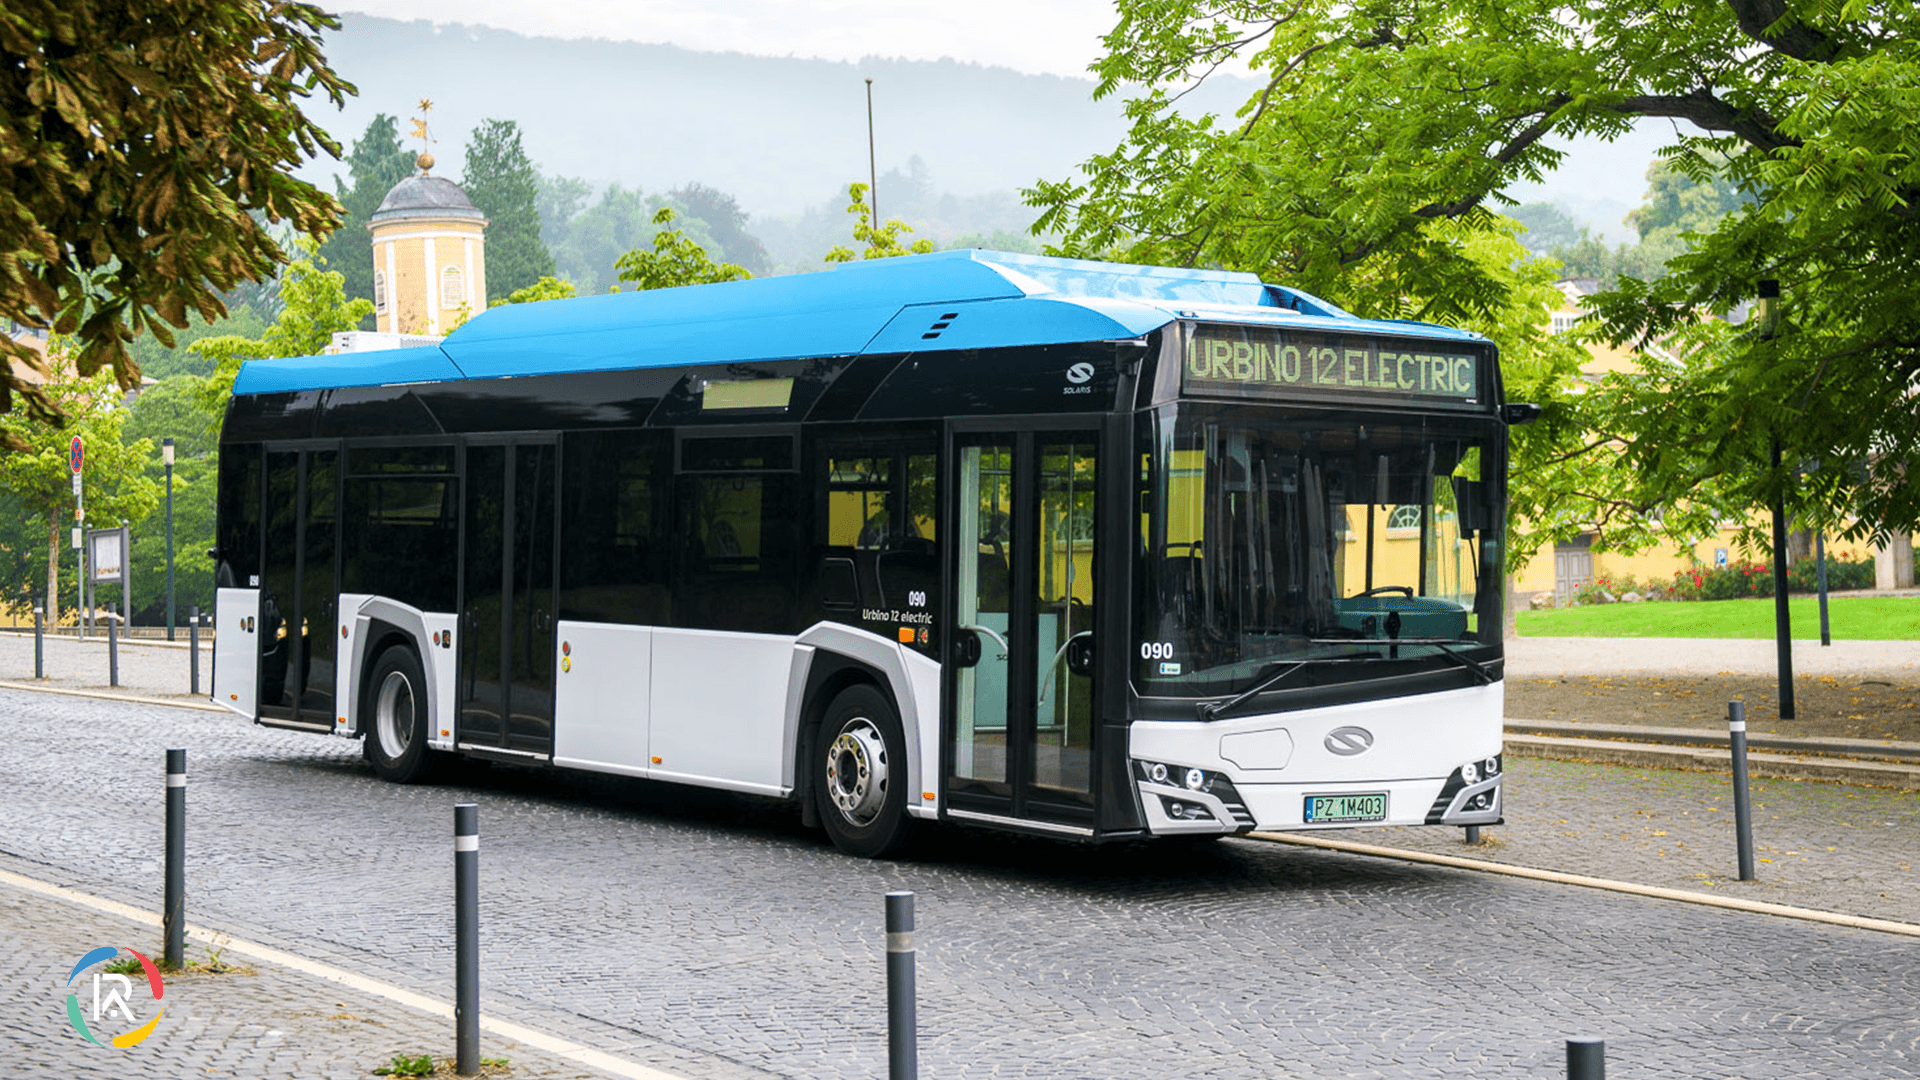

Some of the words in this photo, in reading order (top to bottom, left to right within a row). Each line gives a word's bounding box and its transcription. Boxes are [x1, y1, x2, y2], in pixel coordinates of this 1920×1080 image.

[1189, 338, 1300, 383] URBINO
[1307, 346, 1338, 384] 12
[1344, 349, 1471, 393] ELECTRIC
[1063, 386, 1091, 395] SOLARIS
[908, 590, 926, 607] 090
[862, 608, 890, 621] Urbino
[890, 610, 900, 622] 12
[901, 611, 933, 624] electric
[1141, 642, 1173, 660] 090
[1315, 799, 1334, 816] PZ
[1340, 797, 1382, 815] 1M403
